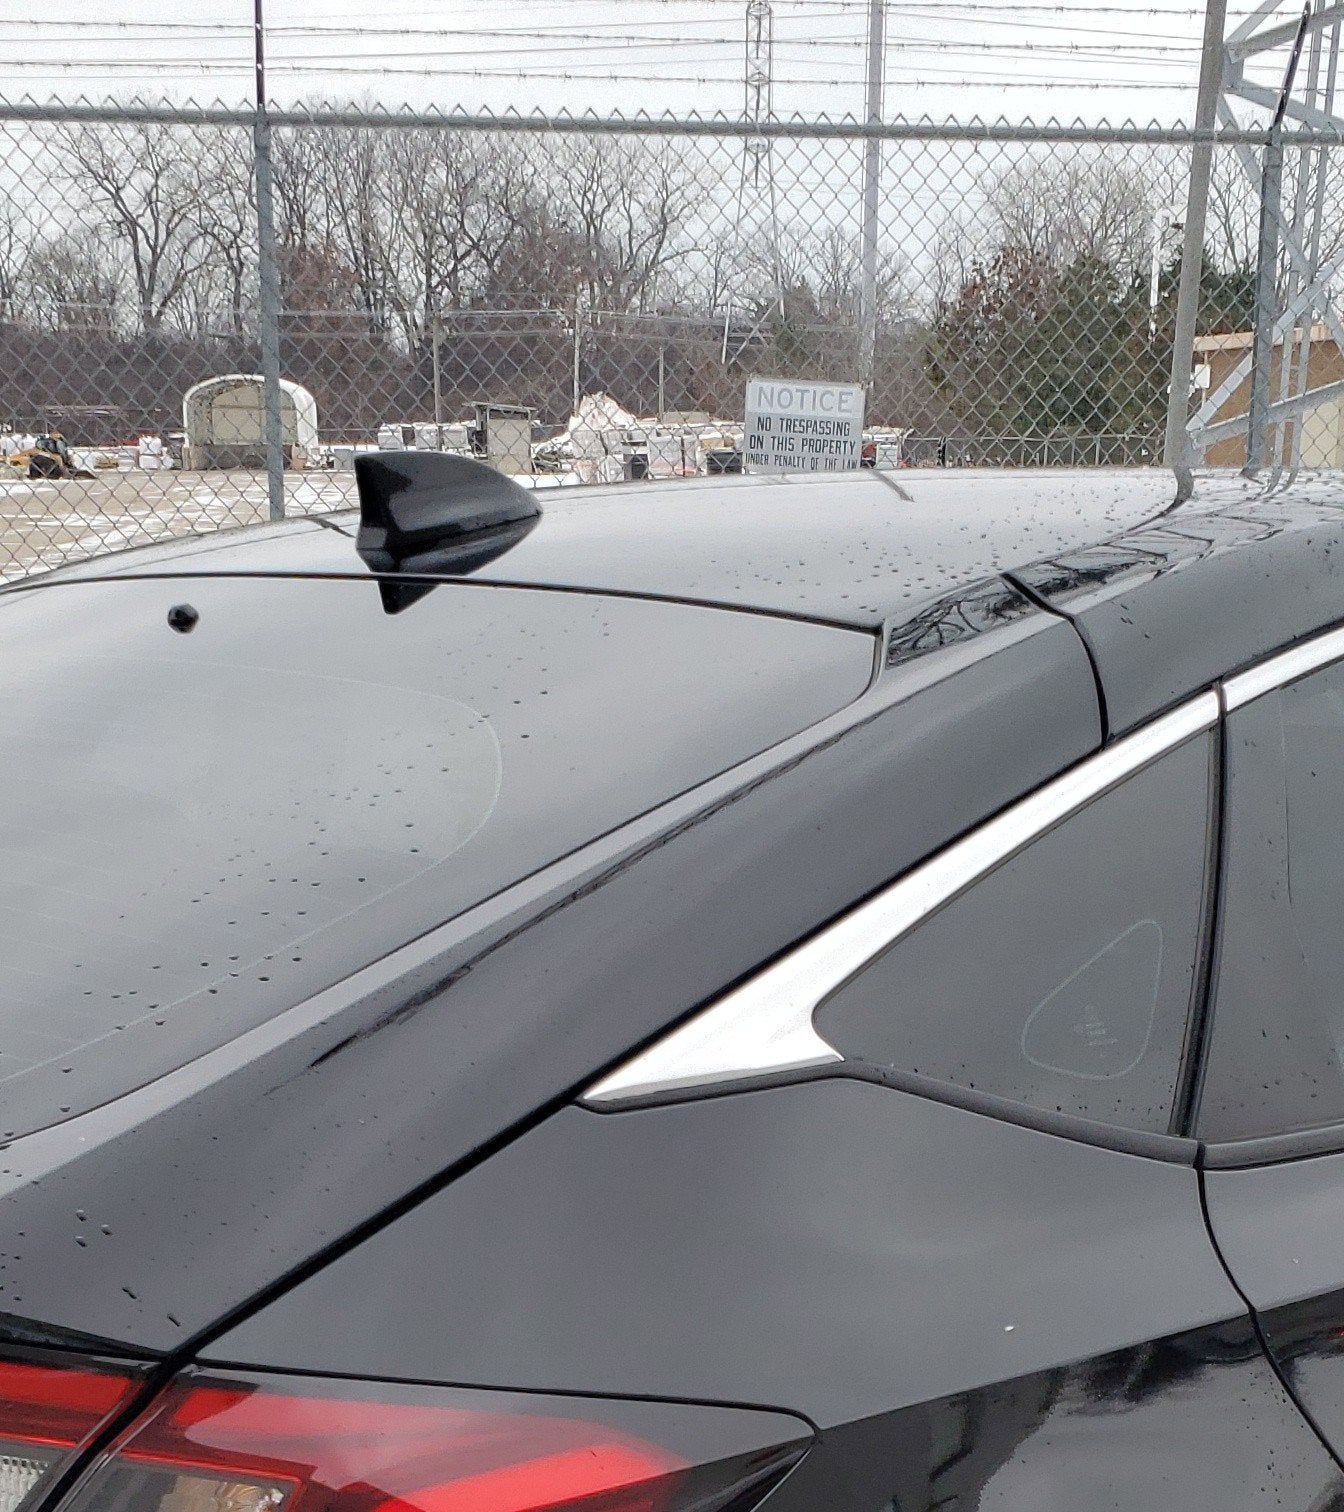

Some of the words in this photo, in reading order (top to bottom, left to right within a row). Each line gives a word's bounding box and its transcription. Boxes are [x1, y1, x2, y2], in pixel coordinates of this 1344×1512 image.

[757, 386, 854, 413] NOTICE
[757, 416, 772, 432] NO
[779, 417, 851, 437] TRESPASSING
[749, 434, 764, 450] ON
[770, 435, 795, 452] THIS
[801, 437, 856, 456] PROPERTY
[745, 452, 769, 466] UNDER
[774, 454, 806, 469] PENALTY
[810, 456, 819, 471] OF
[824, 457, 838, 472] THE
